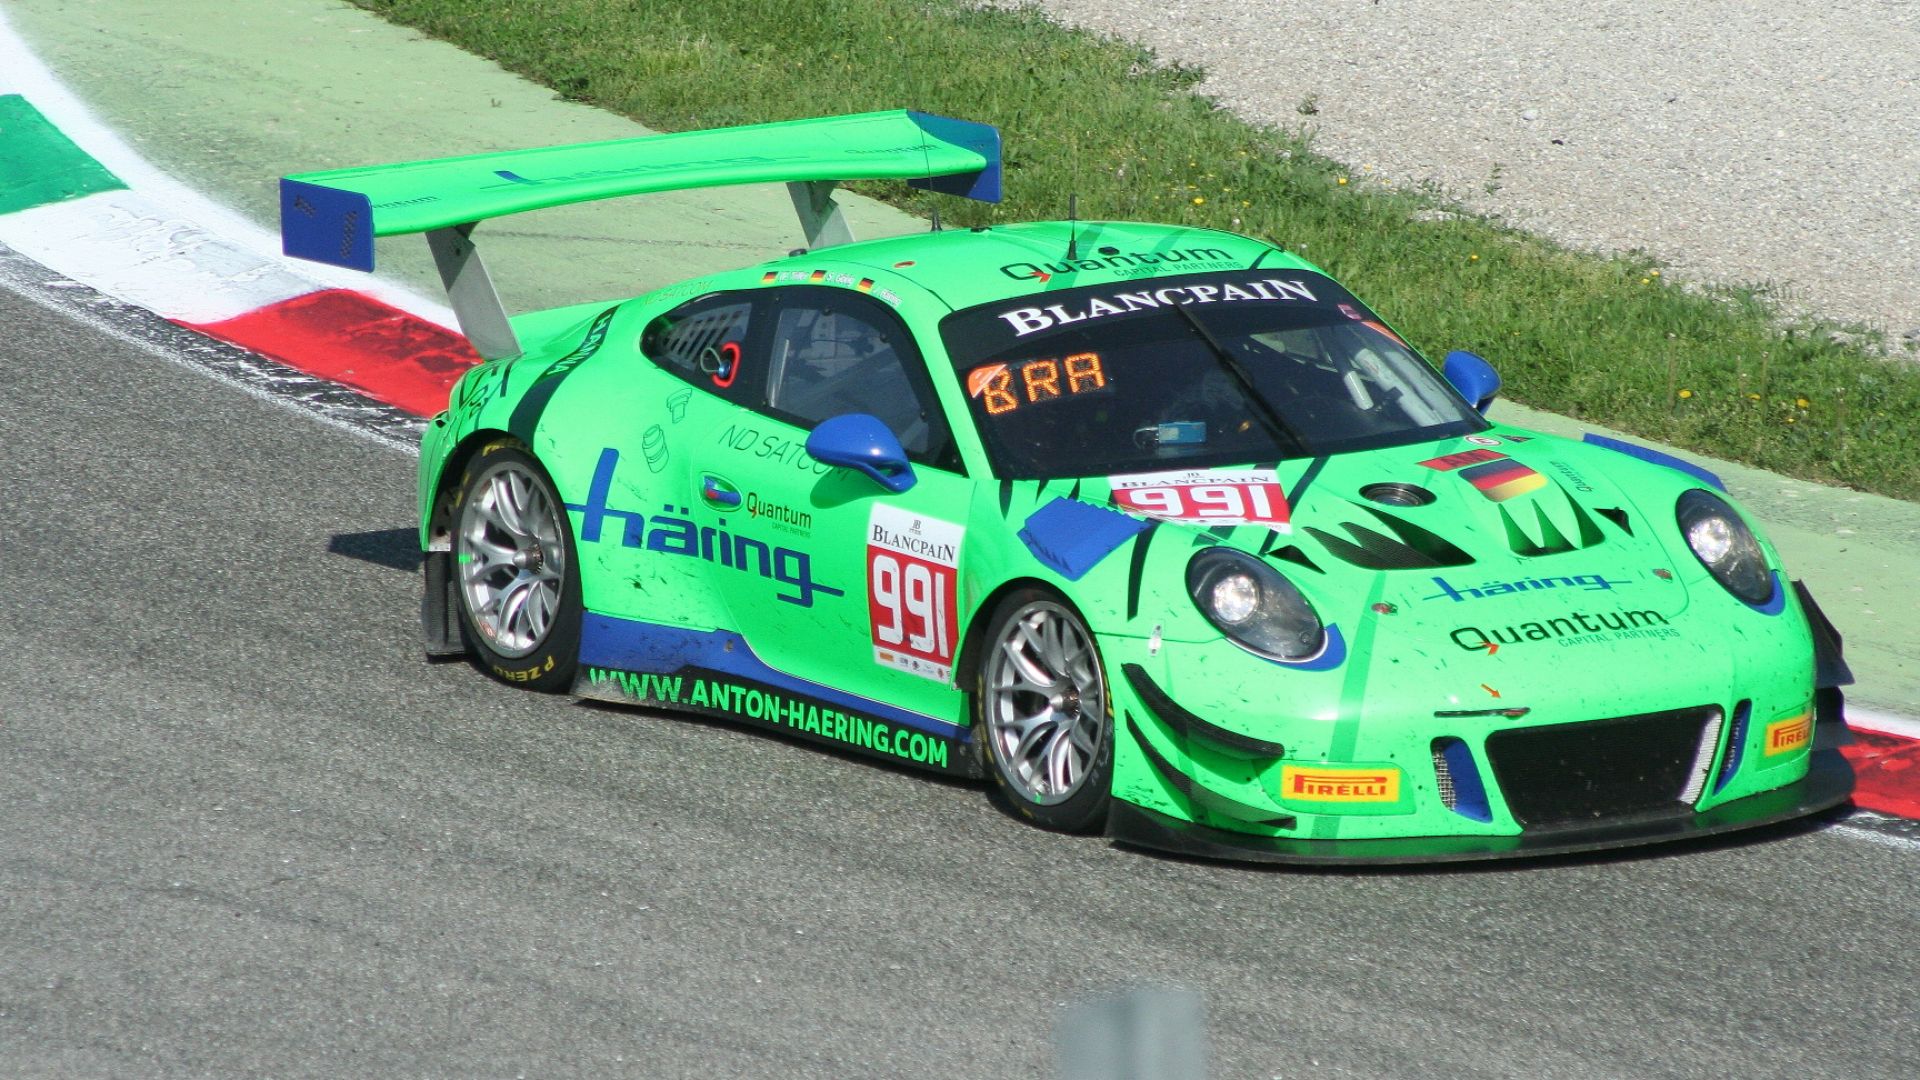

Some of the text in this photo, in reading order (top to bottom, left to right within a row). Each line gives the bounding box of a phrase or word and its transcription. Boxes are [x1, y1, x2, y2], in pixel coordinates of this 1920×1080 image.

[998, 248, 1234, 283] Quantum
[1113, 260, 1244, 277] CAPITAL PARTNERS
[998, 278, 1319, 337] BLANCPAIN
[982, 352, 1107, 415] BRA
[718, 424, 759, 451] ND
[1121, 476, 1270, 489] BLANCPAIN
[746, 491, 812, 529] Quantum
[1130, 485, 1273, 518] 991
[564, 447, 845, 609] häring
[872, 524, 956, 562] BLANCPAIN
[873, 554, 949, 659] 991
[1422, 574, 1633, 603] häring
[1450, 608, 1670, 656] Quantum
[1557, 628, 1681, 648] CAPITAL PARTNERS
[588, 666, 948, 769] WWW.ANTON-HAERING.COM
[1294, 774, 1388, 796] PIRELLI
